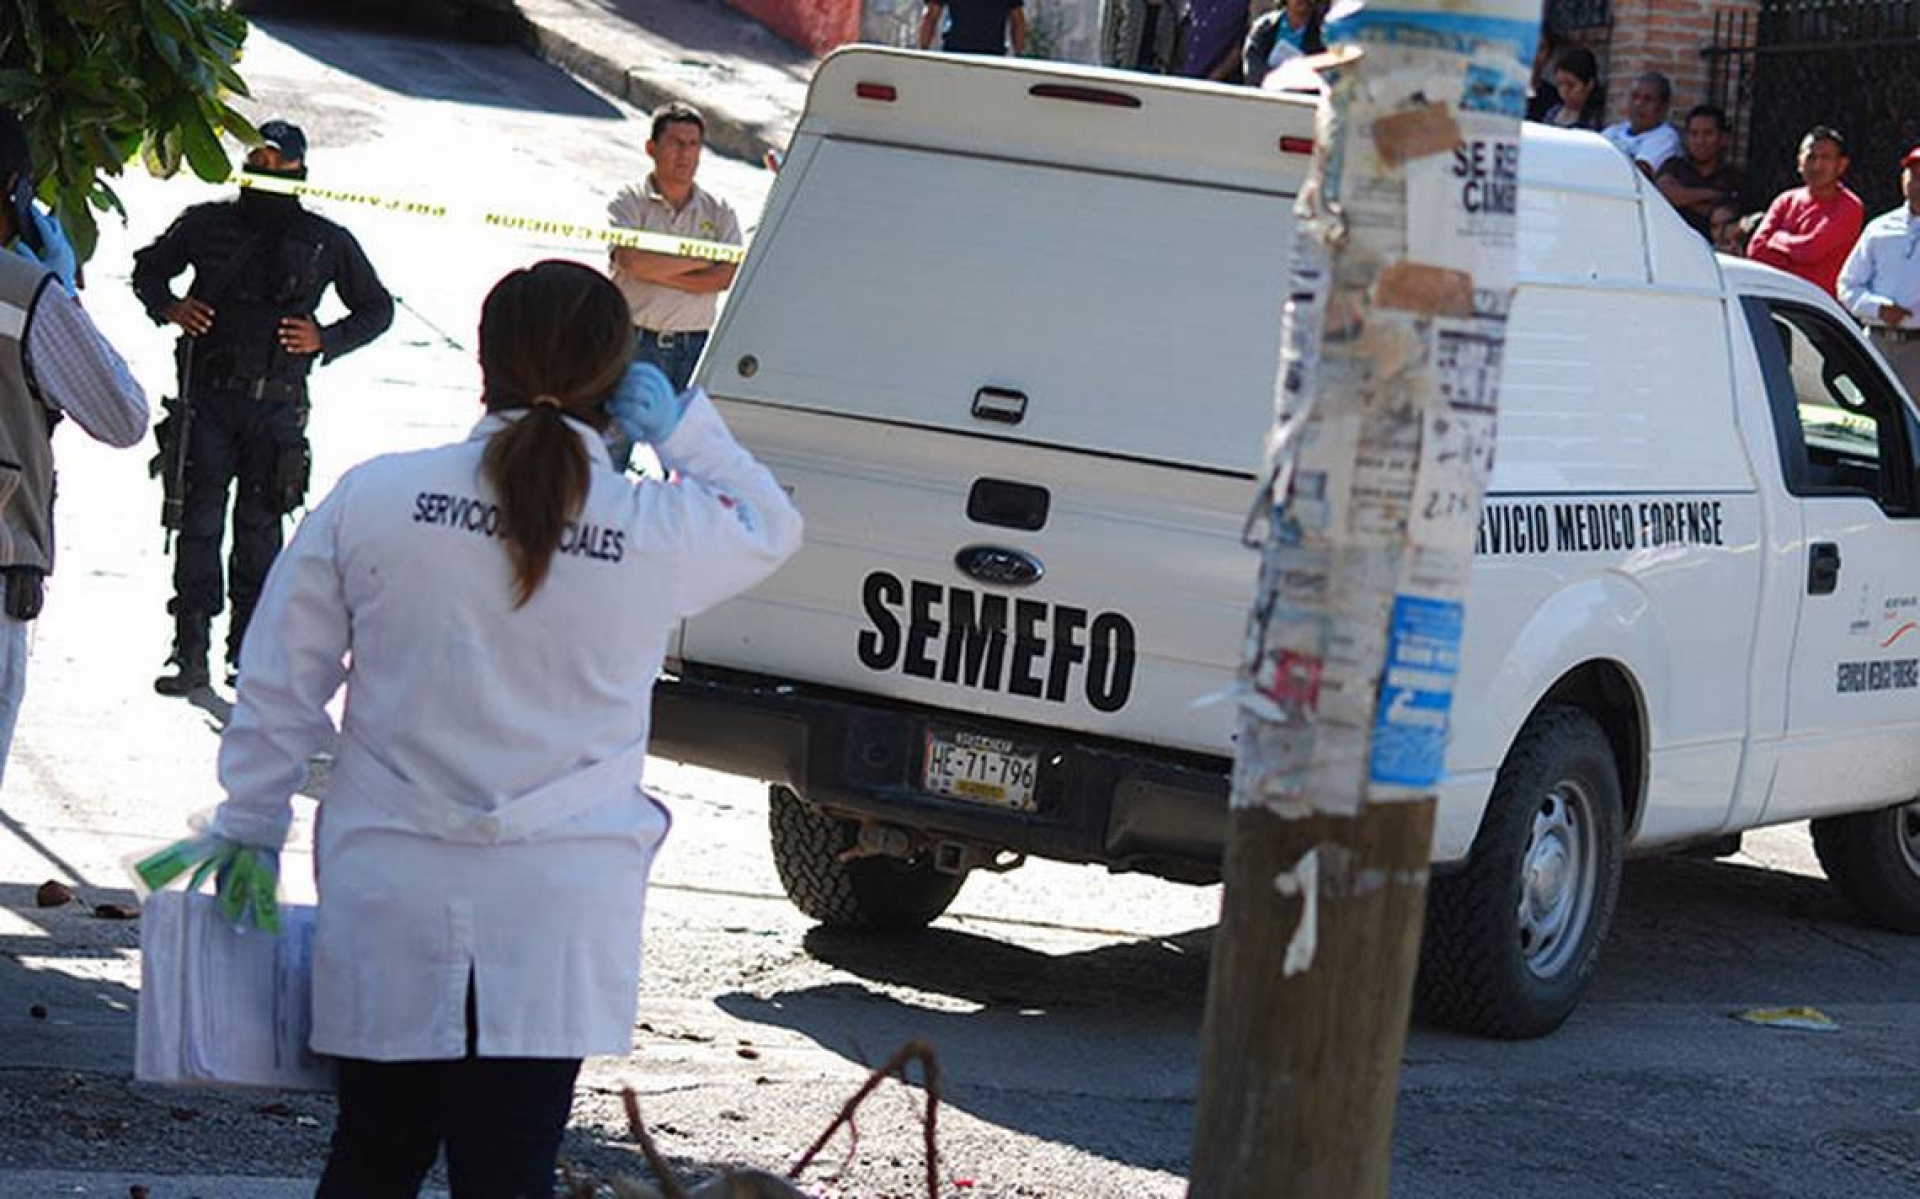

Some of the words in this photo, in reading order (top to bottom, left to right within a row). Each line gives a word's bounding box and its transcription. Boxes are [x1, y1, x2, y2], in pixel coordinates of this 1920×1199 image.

[1555, 502, 1635, 551] MEDICO
[858, 571, 1135, 712] SEMEFO
[929, 746, 1035, 789] HE-71-796
